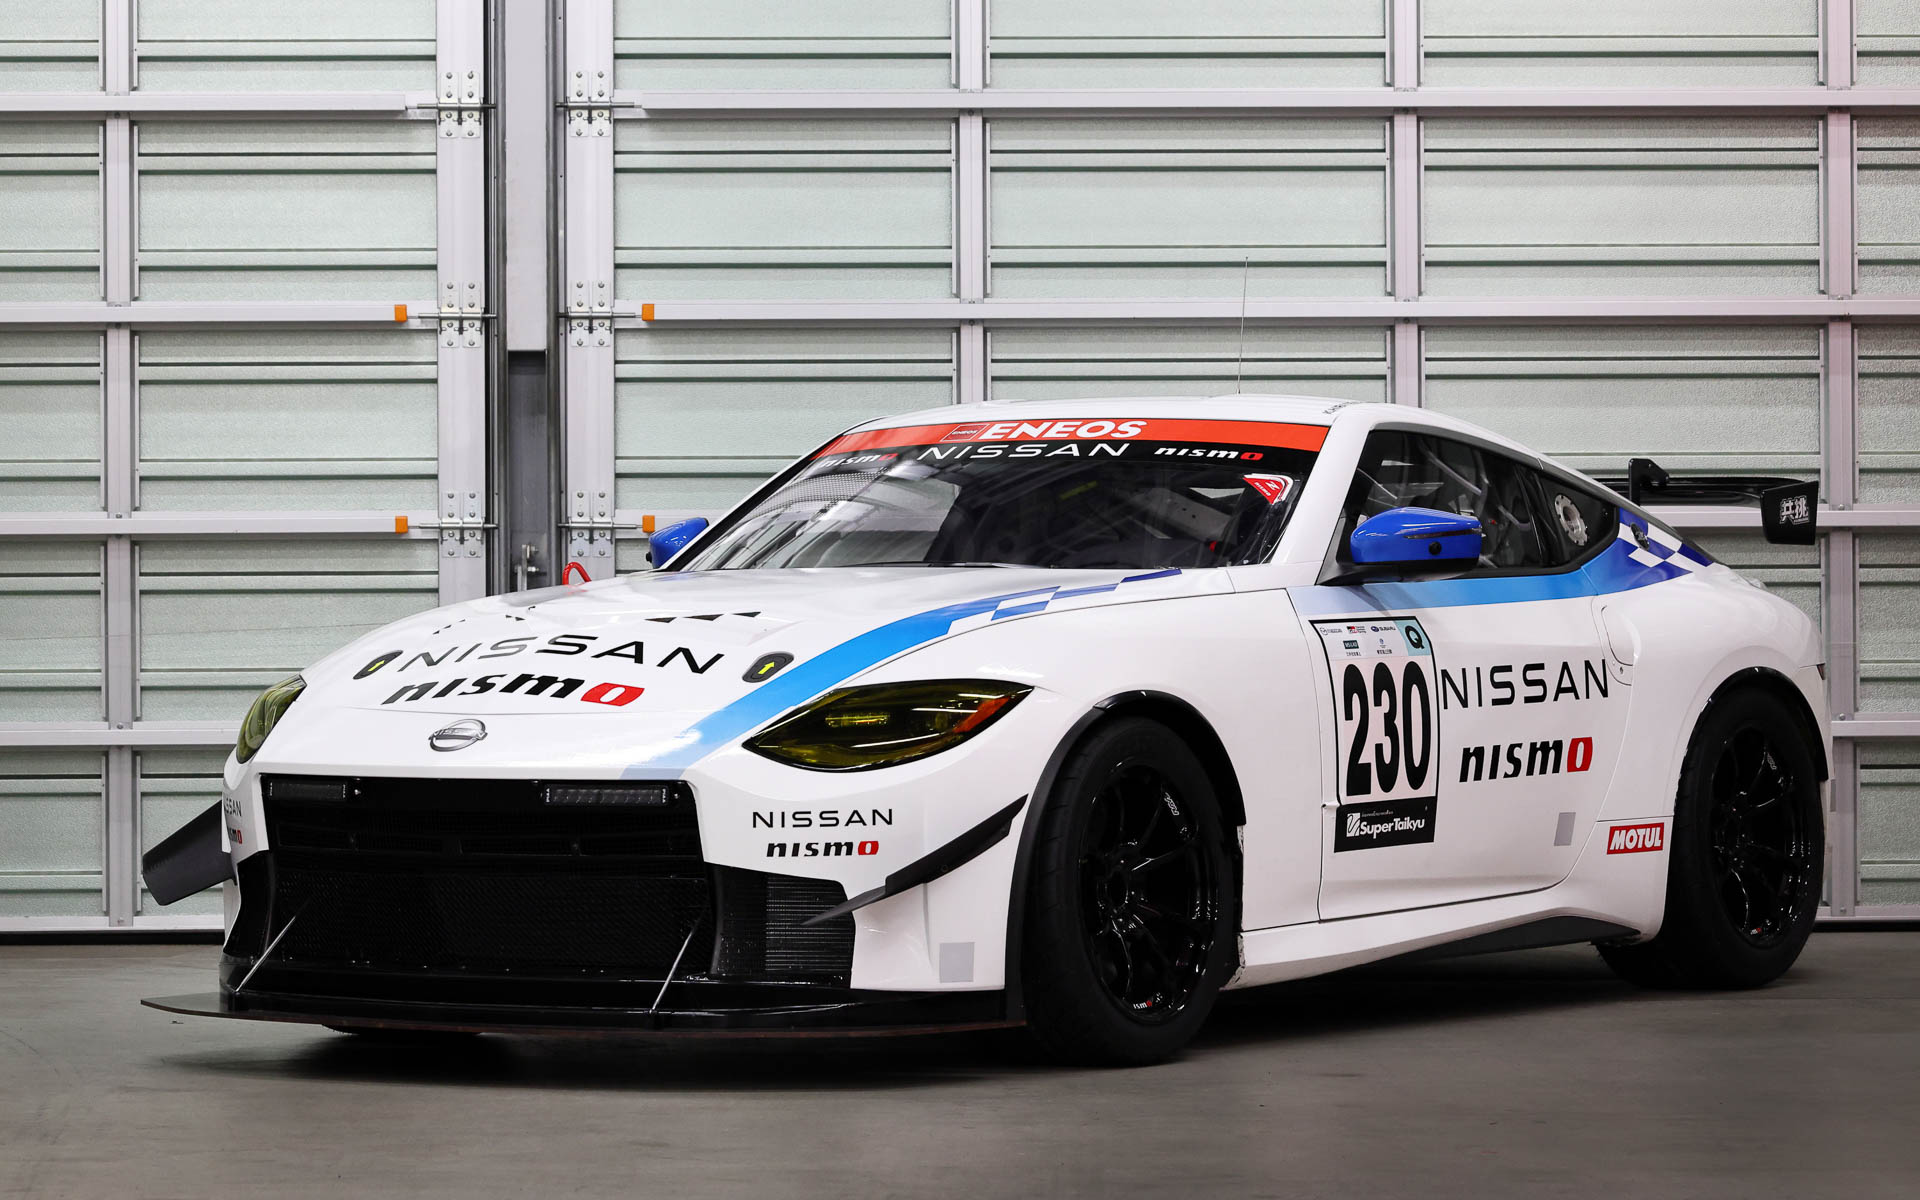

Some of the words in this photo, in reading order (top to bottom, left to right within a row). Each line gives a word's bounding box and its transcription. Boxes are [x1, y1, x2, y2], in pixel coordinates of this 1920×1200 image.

[978, 421, 1147, 440] ENEOS
[820, 453, 899, 467] nismo
[917, 443, 1130, 460] NISSAN
[1154, 446, 1264, 461] nismo
[1404, 625, 1425, 650] Q
[397, 634, 725, 675] NISSAN
[381, 673, 645, 707] nismo
[1440, 658, 1609, 711] NISSAN
[1343, 660, 1432, 797] 230
[1459, 736, 1593, 783] nismo
[752, 808, 893, 829] NISSAN
[766, 840, 880, 858] nismo
[1609, 826, 1662, 851] MOTUL
